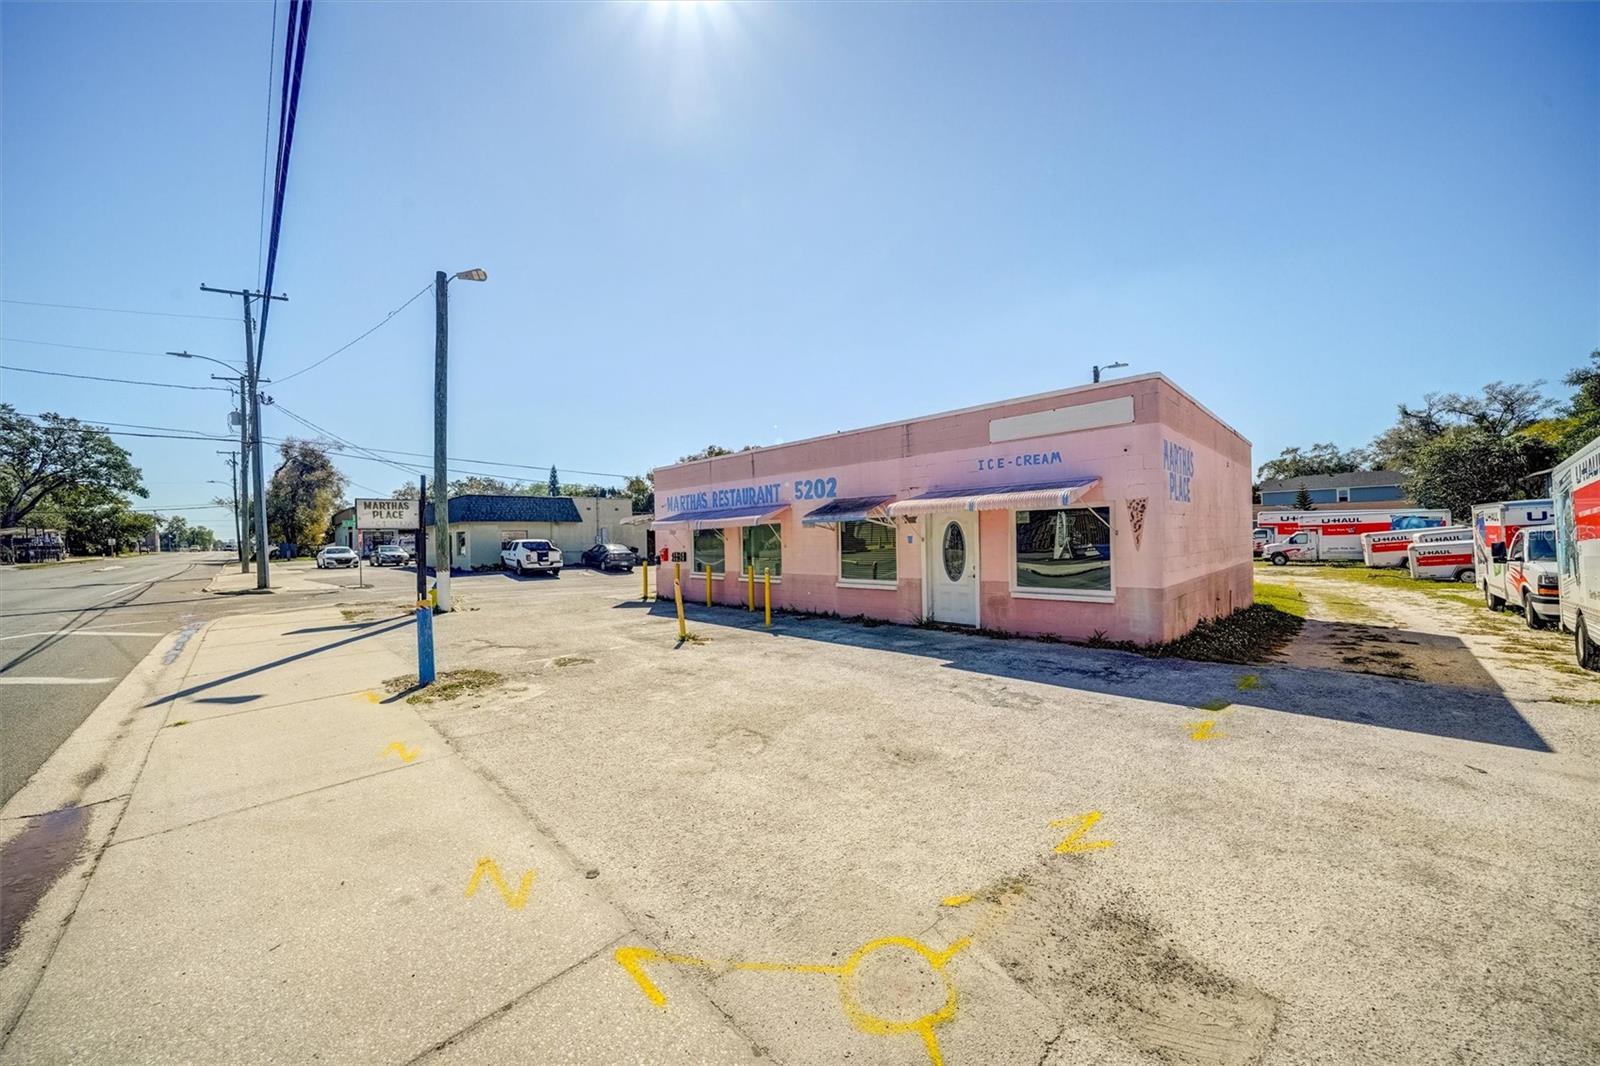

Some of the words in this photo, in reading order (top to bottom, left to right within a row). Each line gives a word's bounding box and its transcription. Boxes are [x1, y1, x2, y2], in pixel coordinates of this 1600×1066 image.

[978, 451, 1062, 471] ICE-CREAM
[712, 483, 781, 508] RESTAURANT
[794, 477, 838, 500] 5202
[363, 501, 410, 510] MARTHAS
[372, 511, 405, 520] PLACE
